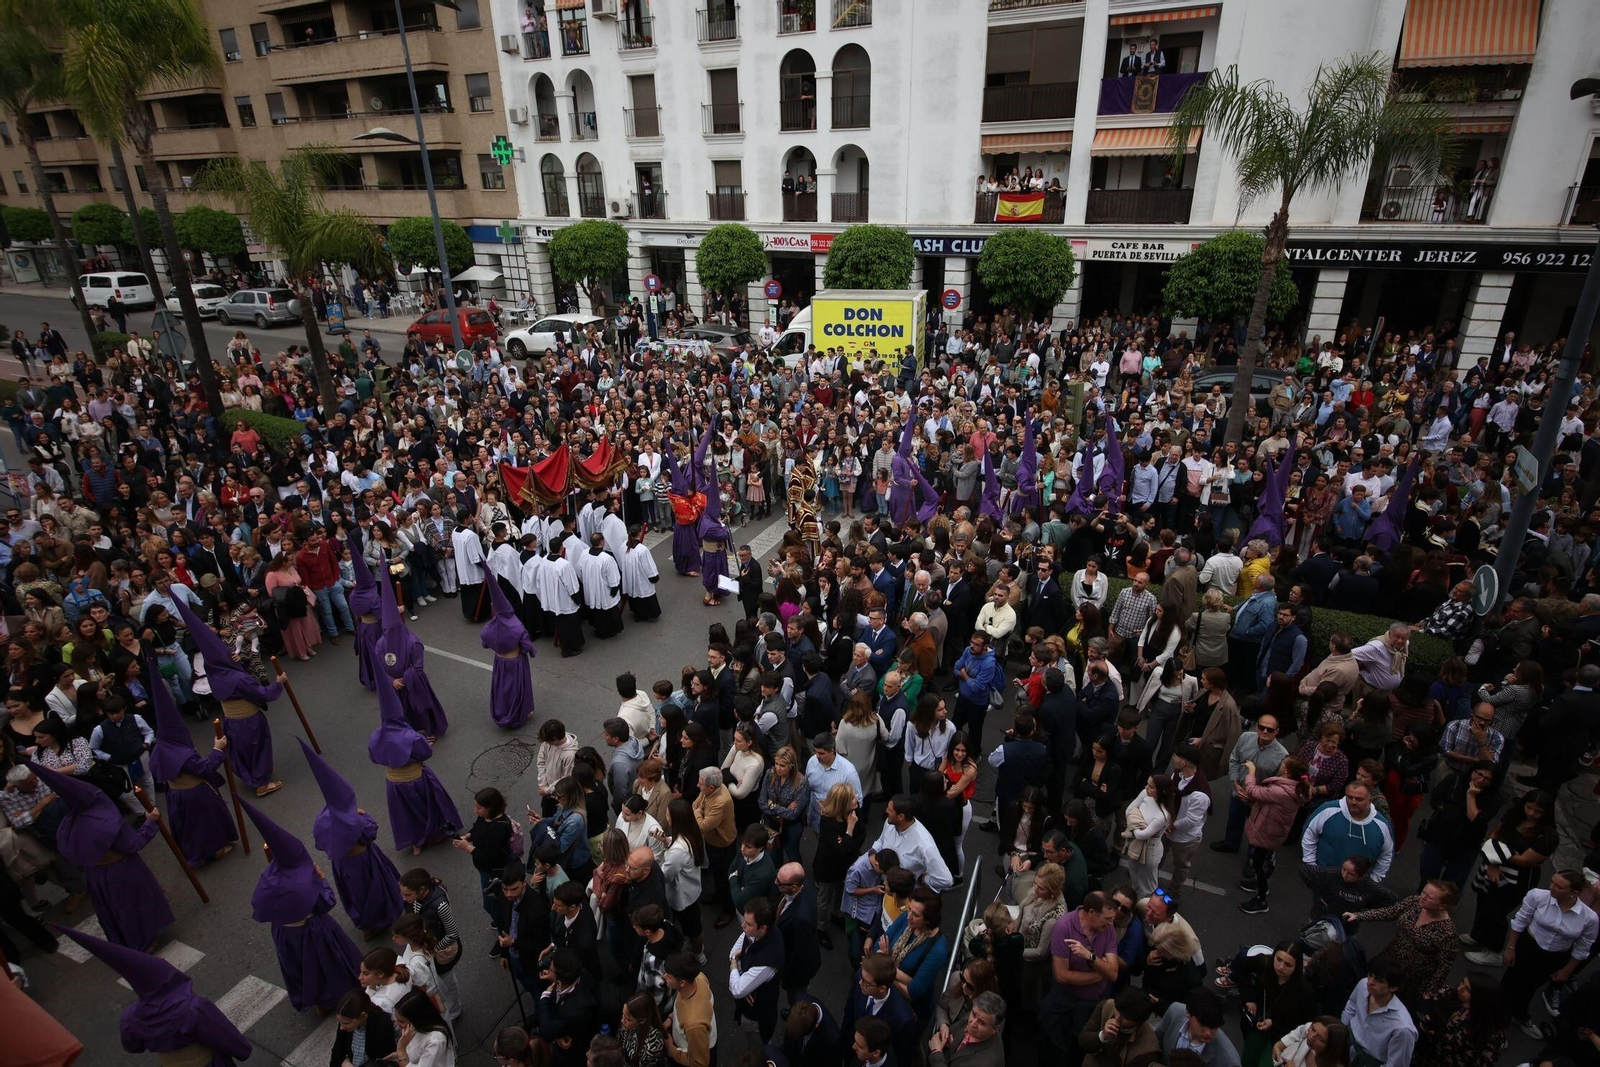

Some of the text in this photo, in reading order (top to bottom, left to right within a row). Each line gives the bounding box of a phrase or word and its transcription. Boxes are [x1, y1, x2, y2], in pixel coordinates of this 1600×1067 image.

[773, 236, 789, 246] 100%
[951, 239, 984, 253] CLU
[1111, 242, 1139, 250] CAFE
[1092, 250, 1181, 261] PUERTA DE SEVILLA
[1284, 248, 1402, 262] NTALCENTER
[1414, 250, 1477, 263] JEREZ
[1502, 251, 1532, 265] 956
[1535, 252, 1566, 266] 922
[844, 307, 883, 321] DON
[823, 323, 904, 337] COLCHON
